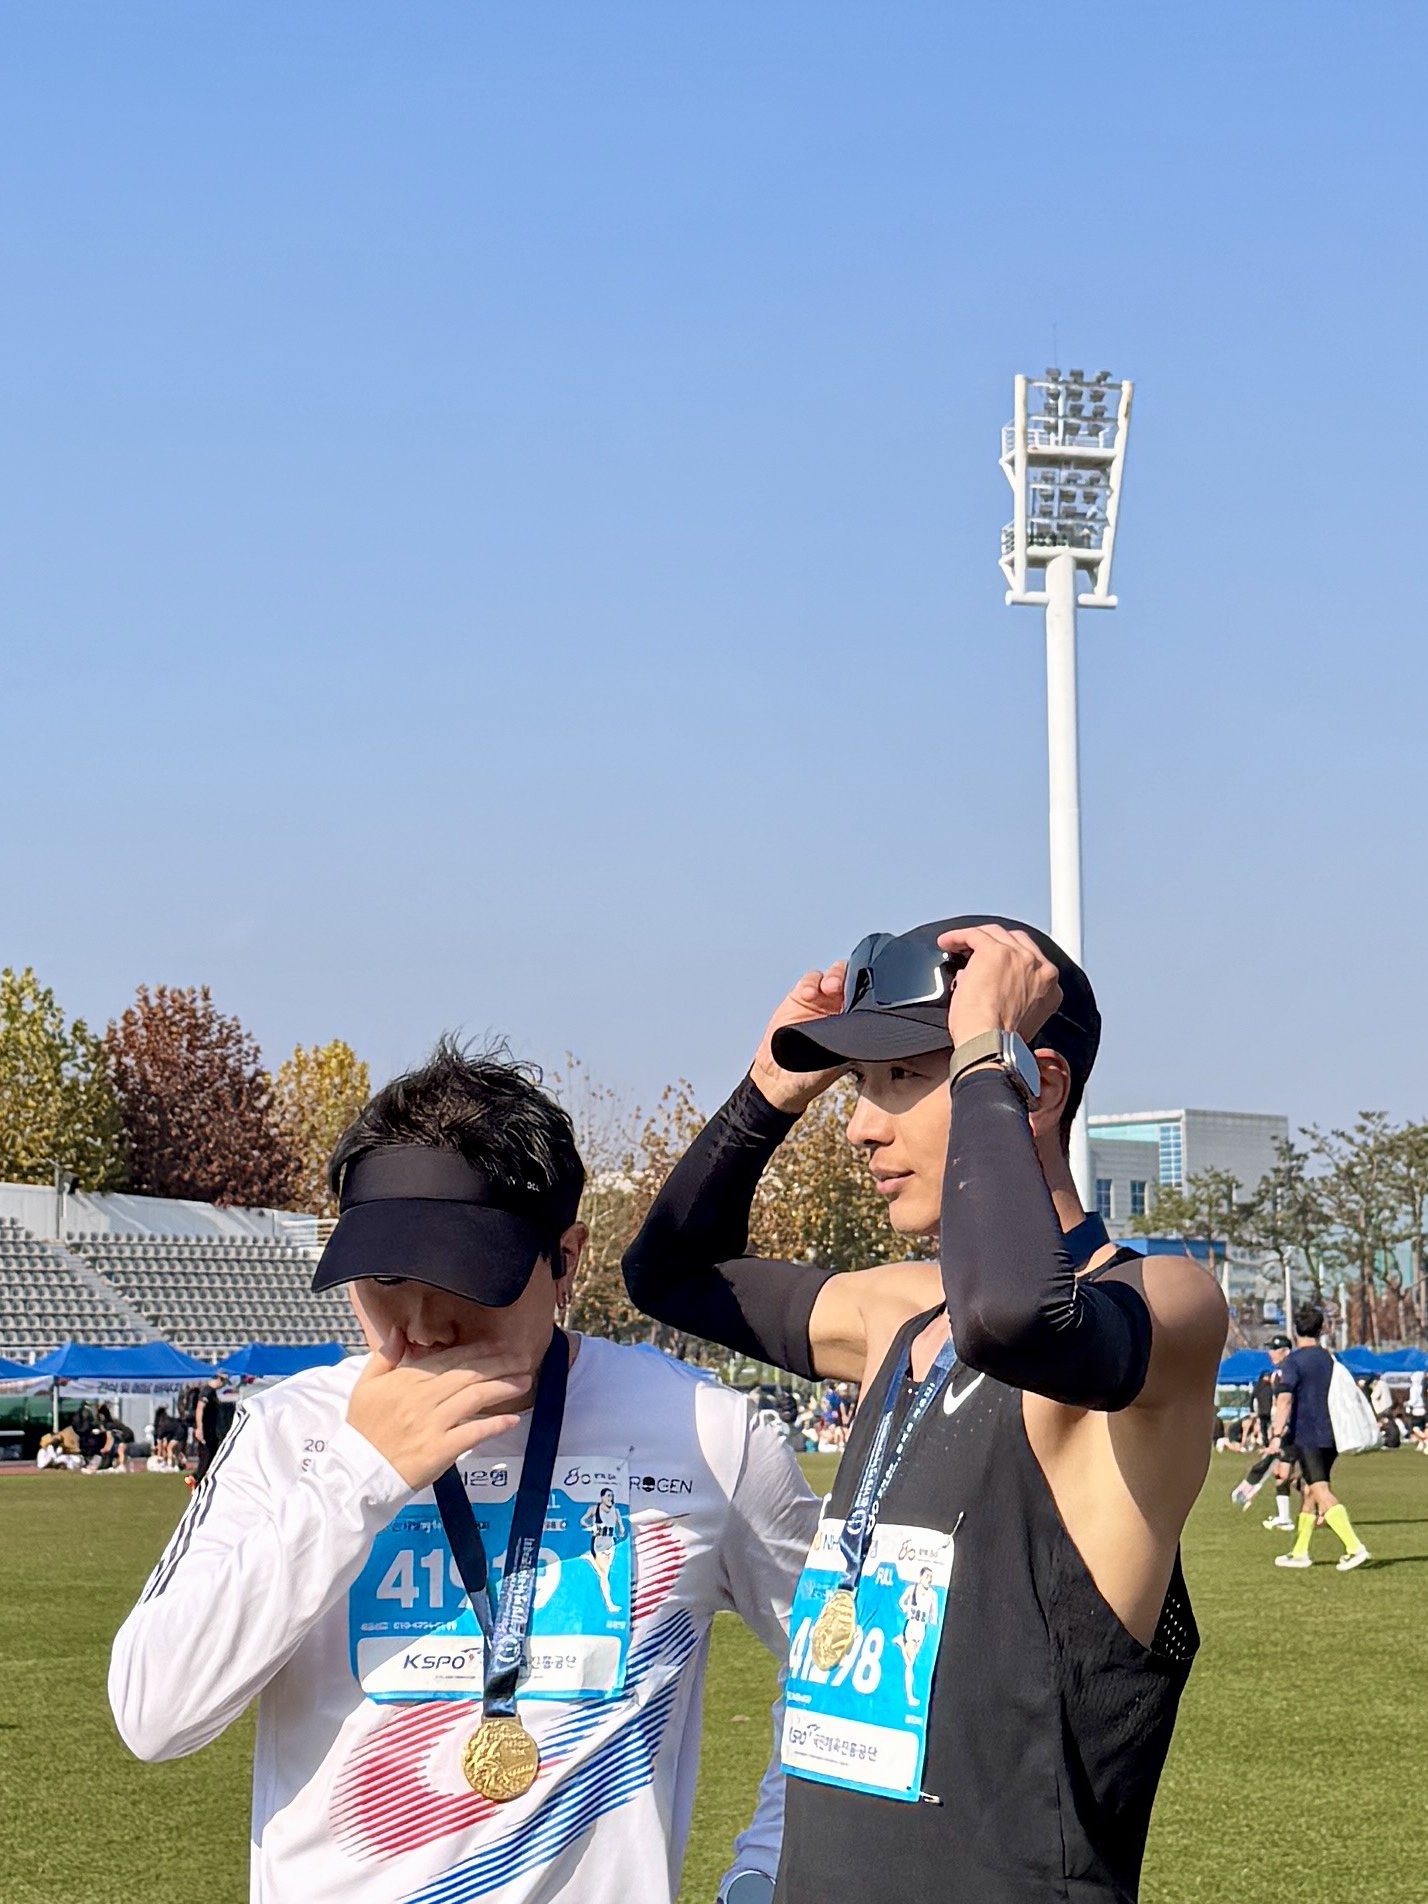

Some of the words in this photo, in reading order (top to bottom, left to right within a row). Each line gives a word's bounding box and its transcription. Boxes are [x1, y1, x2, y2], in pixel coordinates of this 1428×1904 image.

[629, 1475, 694, 1494] ROGEN
[376, 1547, 562, 1609] 419
[403, 1653, 466, 1670] KSPO
